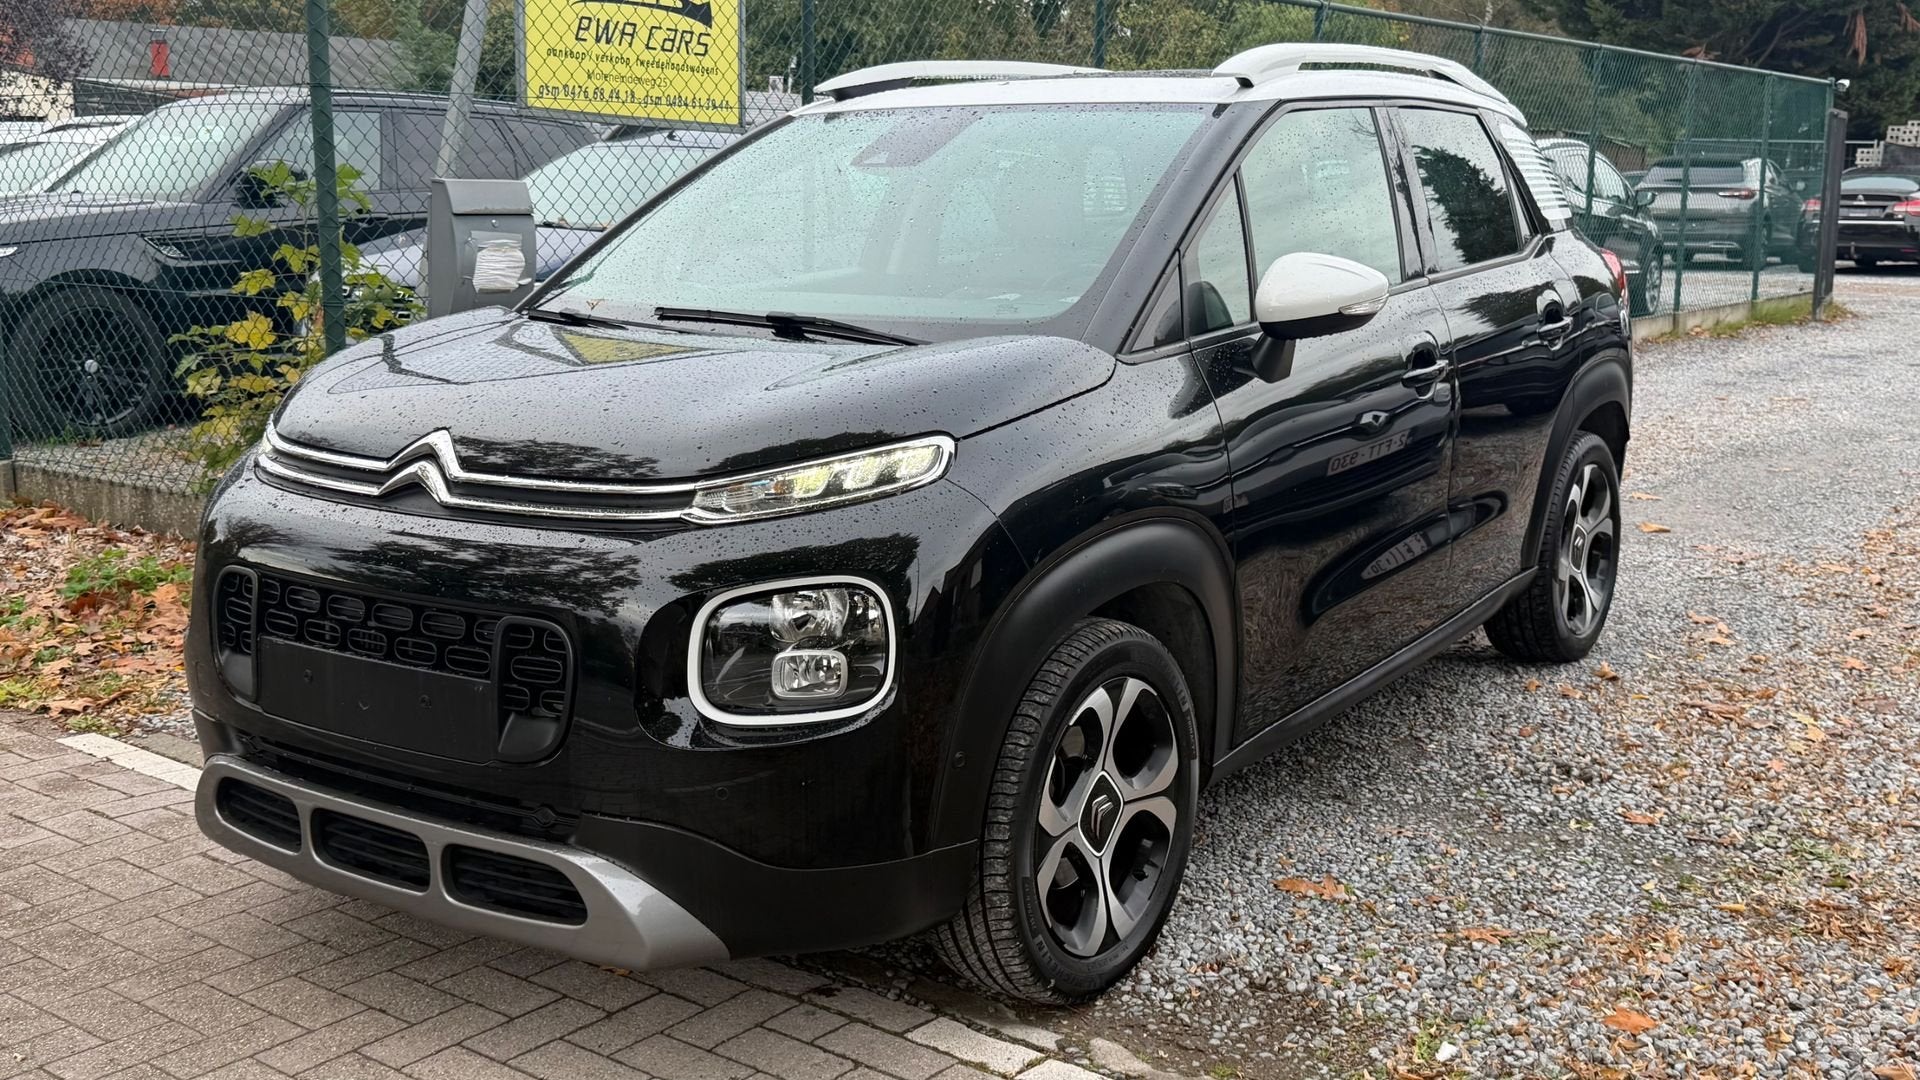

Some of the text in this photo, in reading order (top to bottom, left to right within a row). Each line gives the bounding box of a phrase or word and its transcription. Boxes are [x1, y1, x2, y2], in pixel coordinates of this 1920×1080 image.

[546, 47, 587, 61] aankoop
[595, 52, 631, 67] verkoop
[636, 56, 719, 76] tweedehandswagens
[538, 85, 560, 98] gsm
[643, 94, 662, 108] gsm
